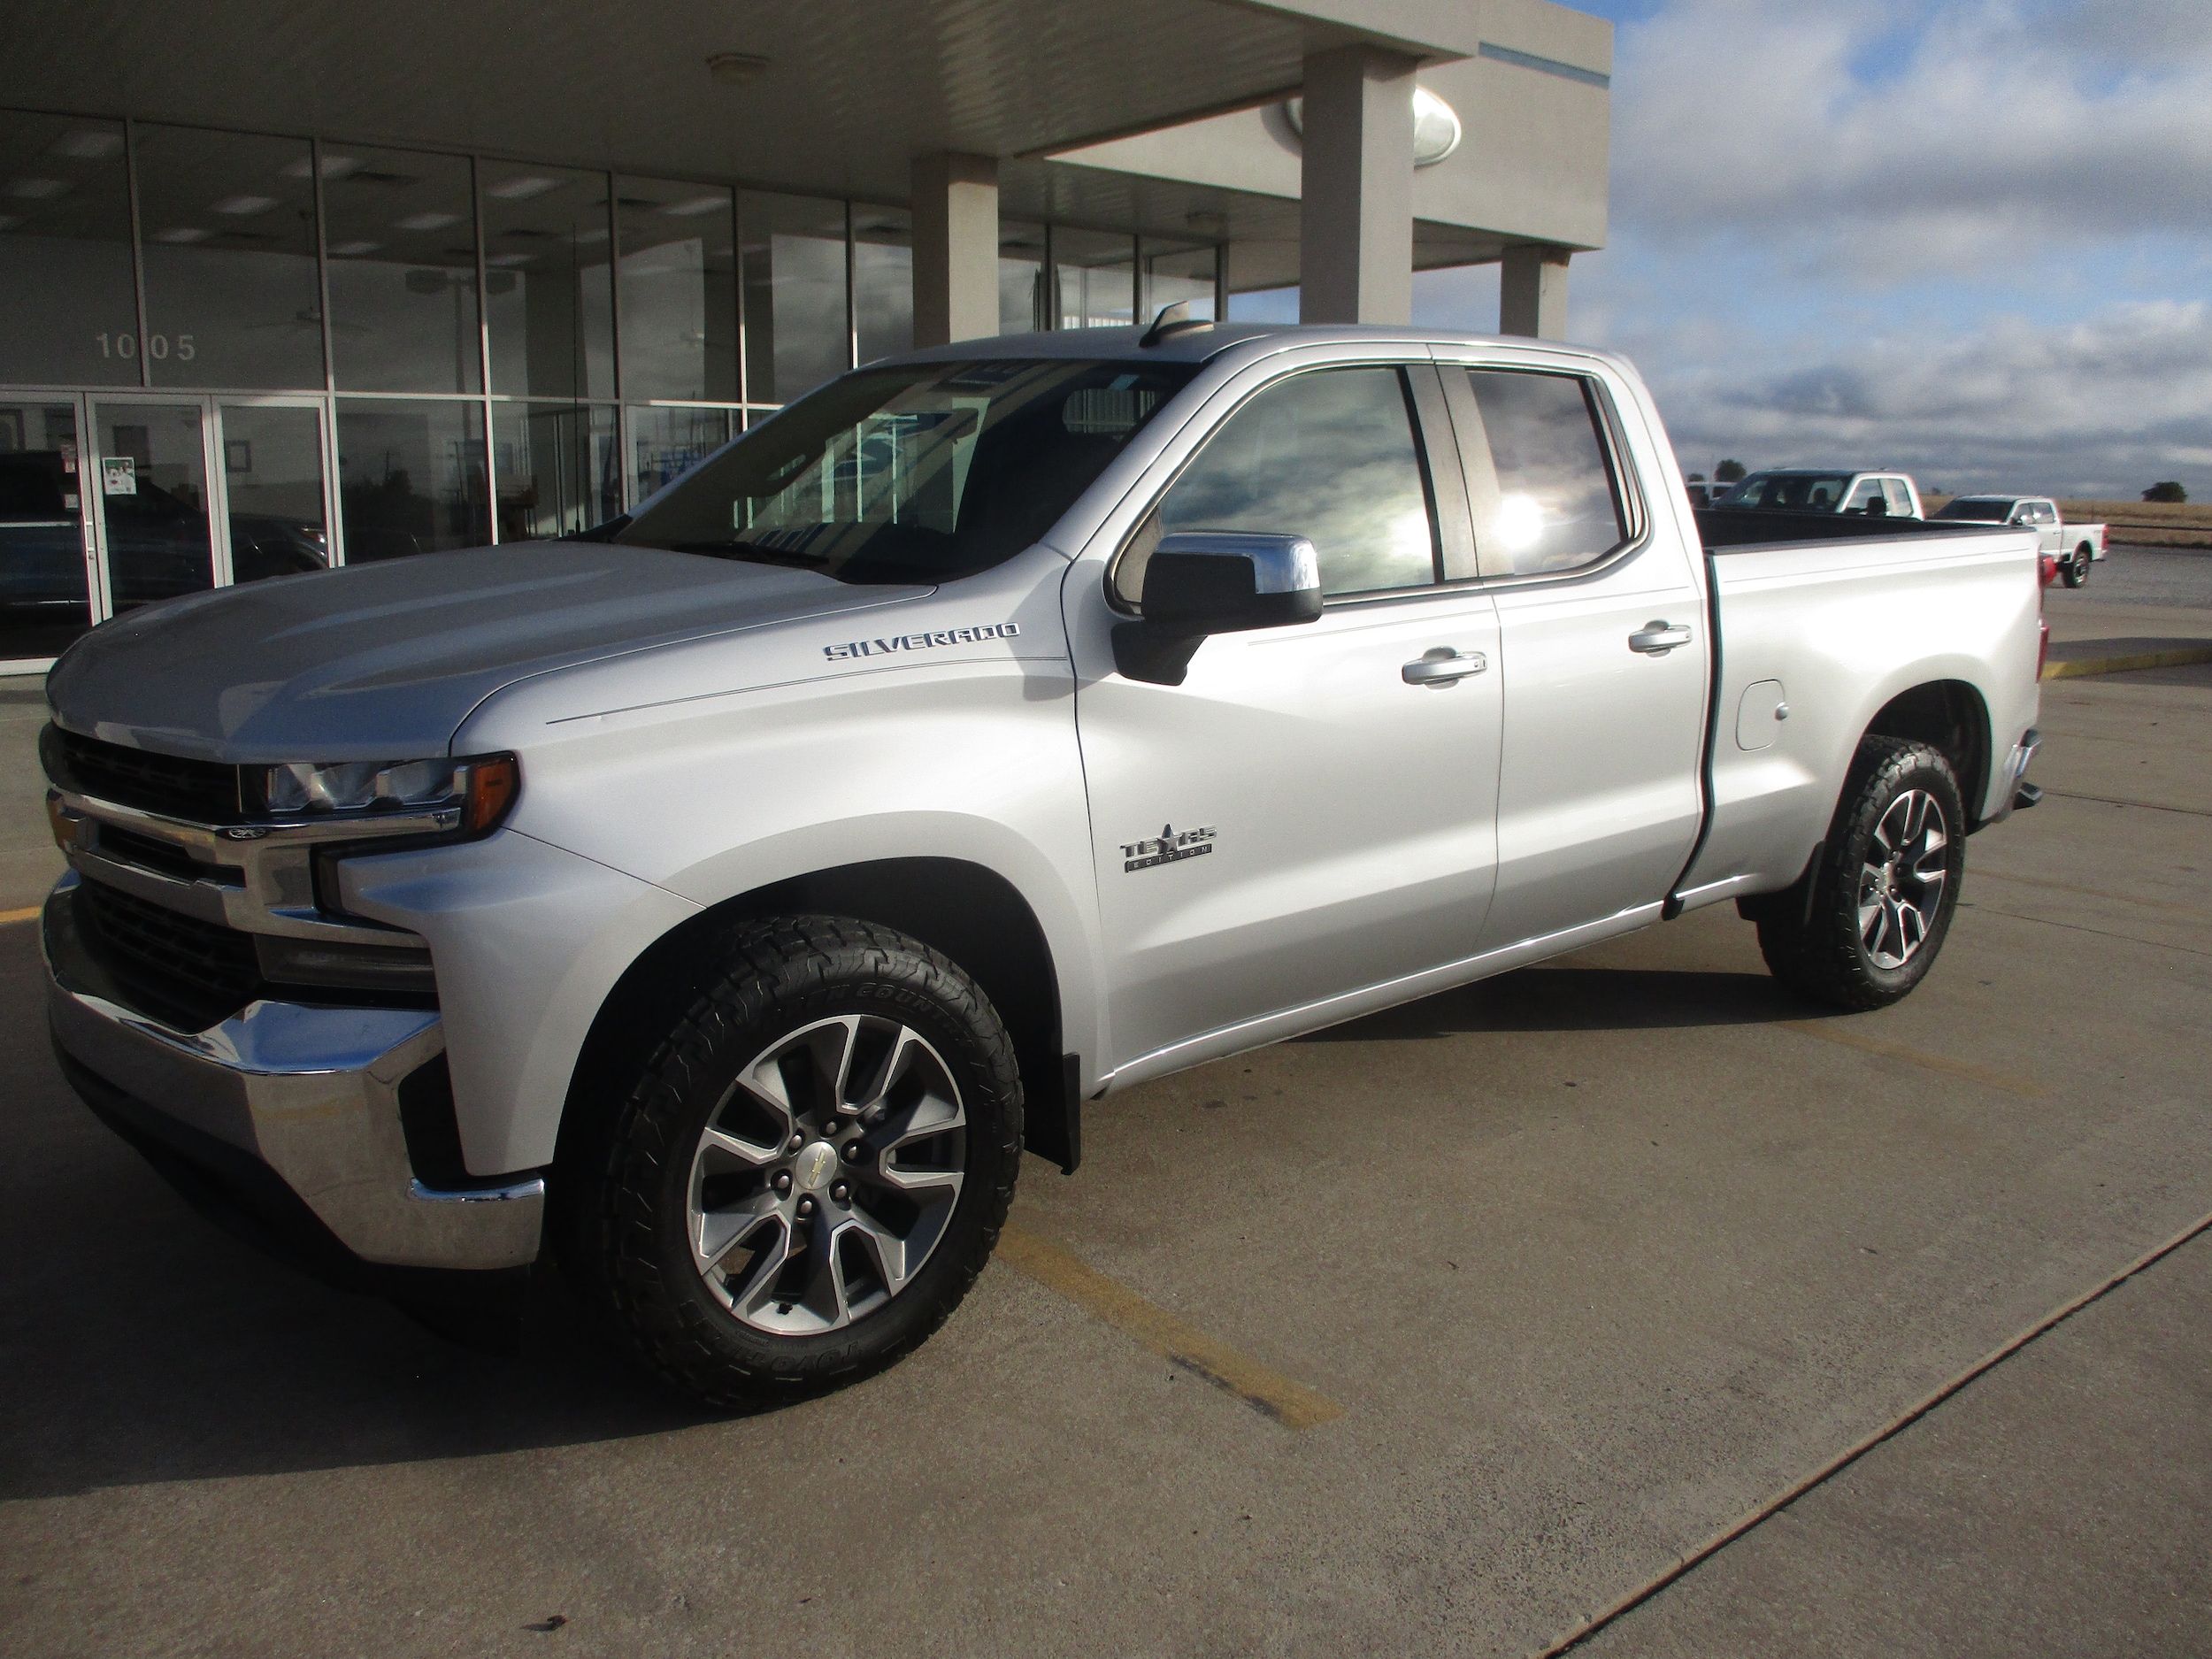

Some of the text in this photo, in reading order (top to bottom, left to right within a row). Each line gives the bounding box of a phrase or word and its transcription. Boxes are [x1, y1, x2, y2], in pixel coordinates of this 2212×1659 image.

[96, 333, 196, 360] 1005
[824, 622, 1021, 661] SILVERADO
[1130, 845, 1210, 870] EDITION
